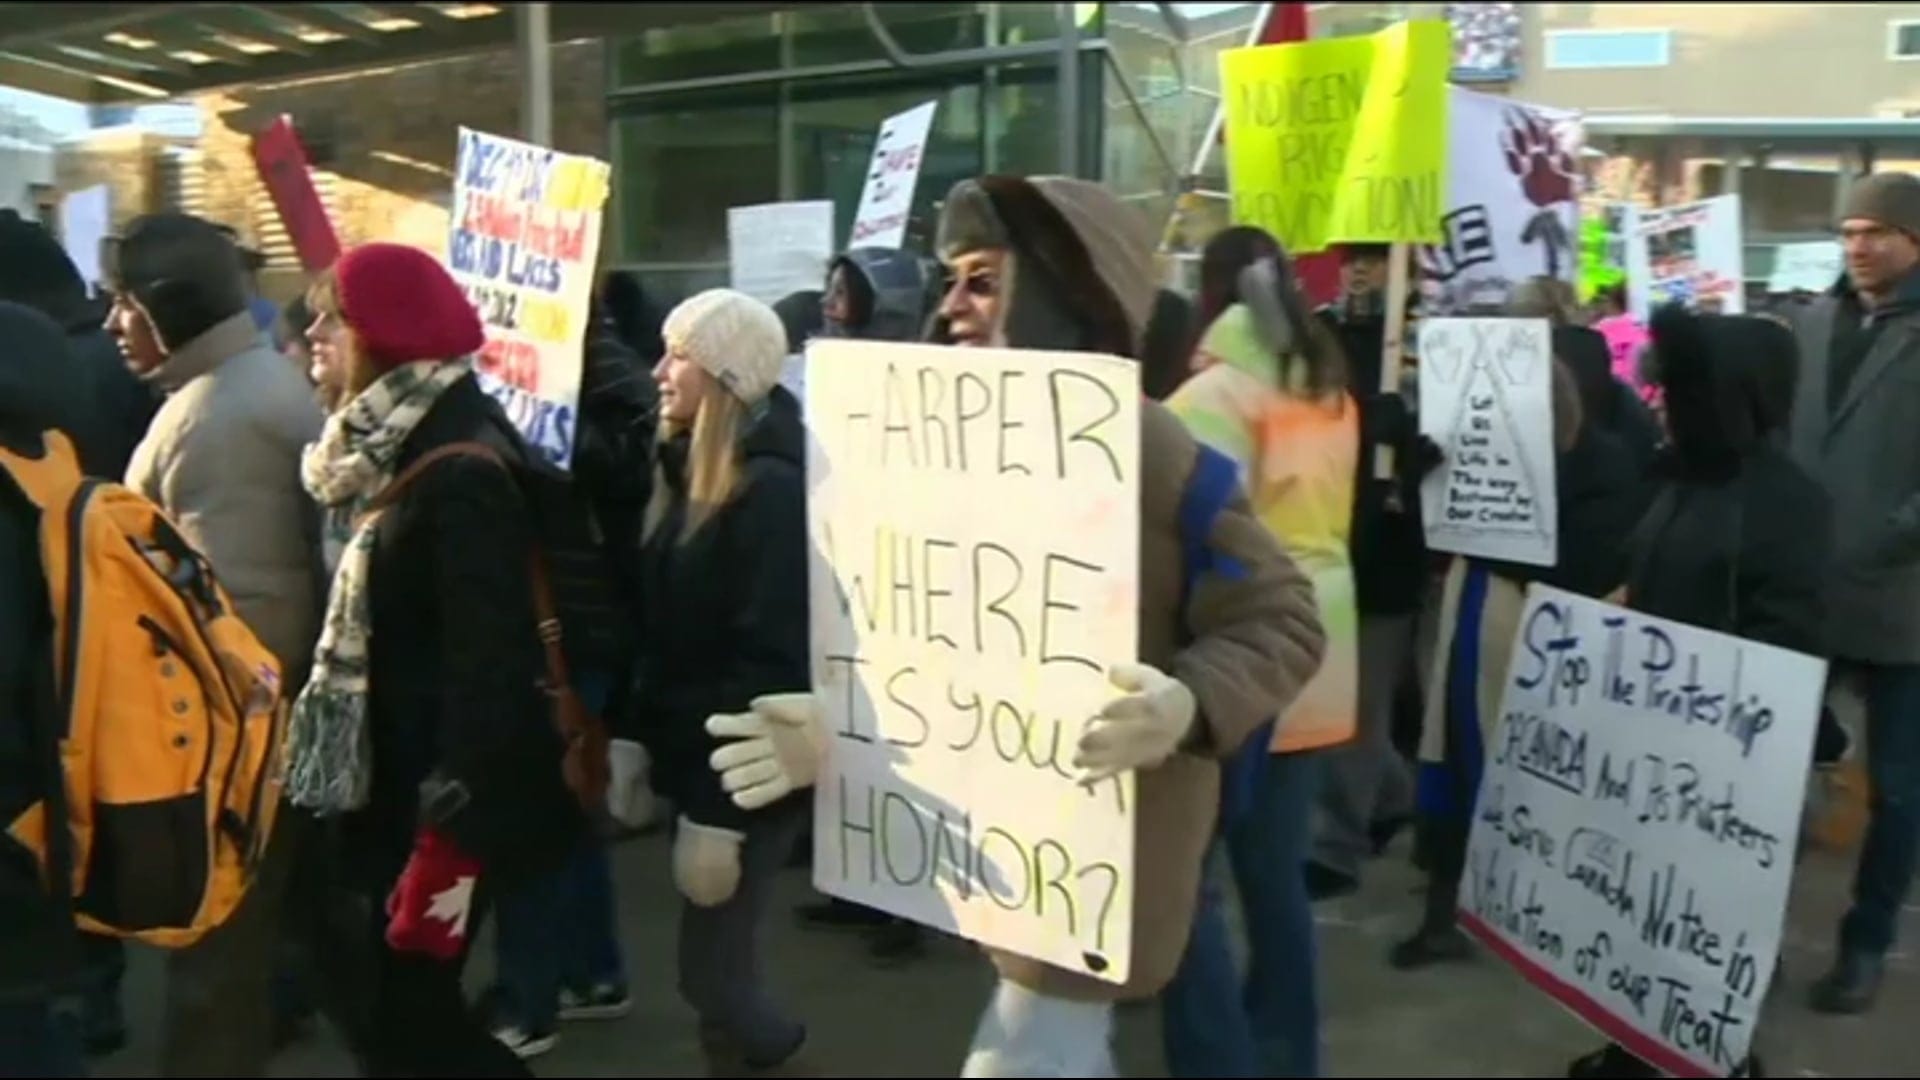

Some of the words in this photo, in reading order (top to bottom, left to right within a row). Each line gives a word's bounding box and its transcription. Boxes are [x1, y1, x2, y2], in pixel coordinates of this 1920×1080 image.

[847, 361, 1123, 483] ARPER
[1452, 469, 1482, 486] The
[1446, 506, 1474, 521] Our
[1477, 507, 1532, 522] Creator
[823, 520, 1105, 673] WHERE
[1515, 602, 1590, 707] Stop
[1601, 616, 1635, 706] The
[825, 654, 930, 748] IS
[947, 682, 1125, 816] you
[839, 773, 1119, 972] HONOR?
[1641, 864, 1722, 966] Notice
[1724, 931, 1758, 999] in
[1573, 930, 1612, 984] of
